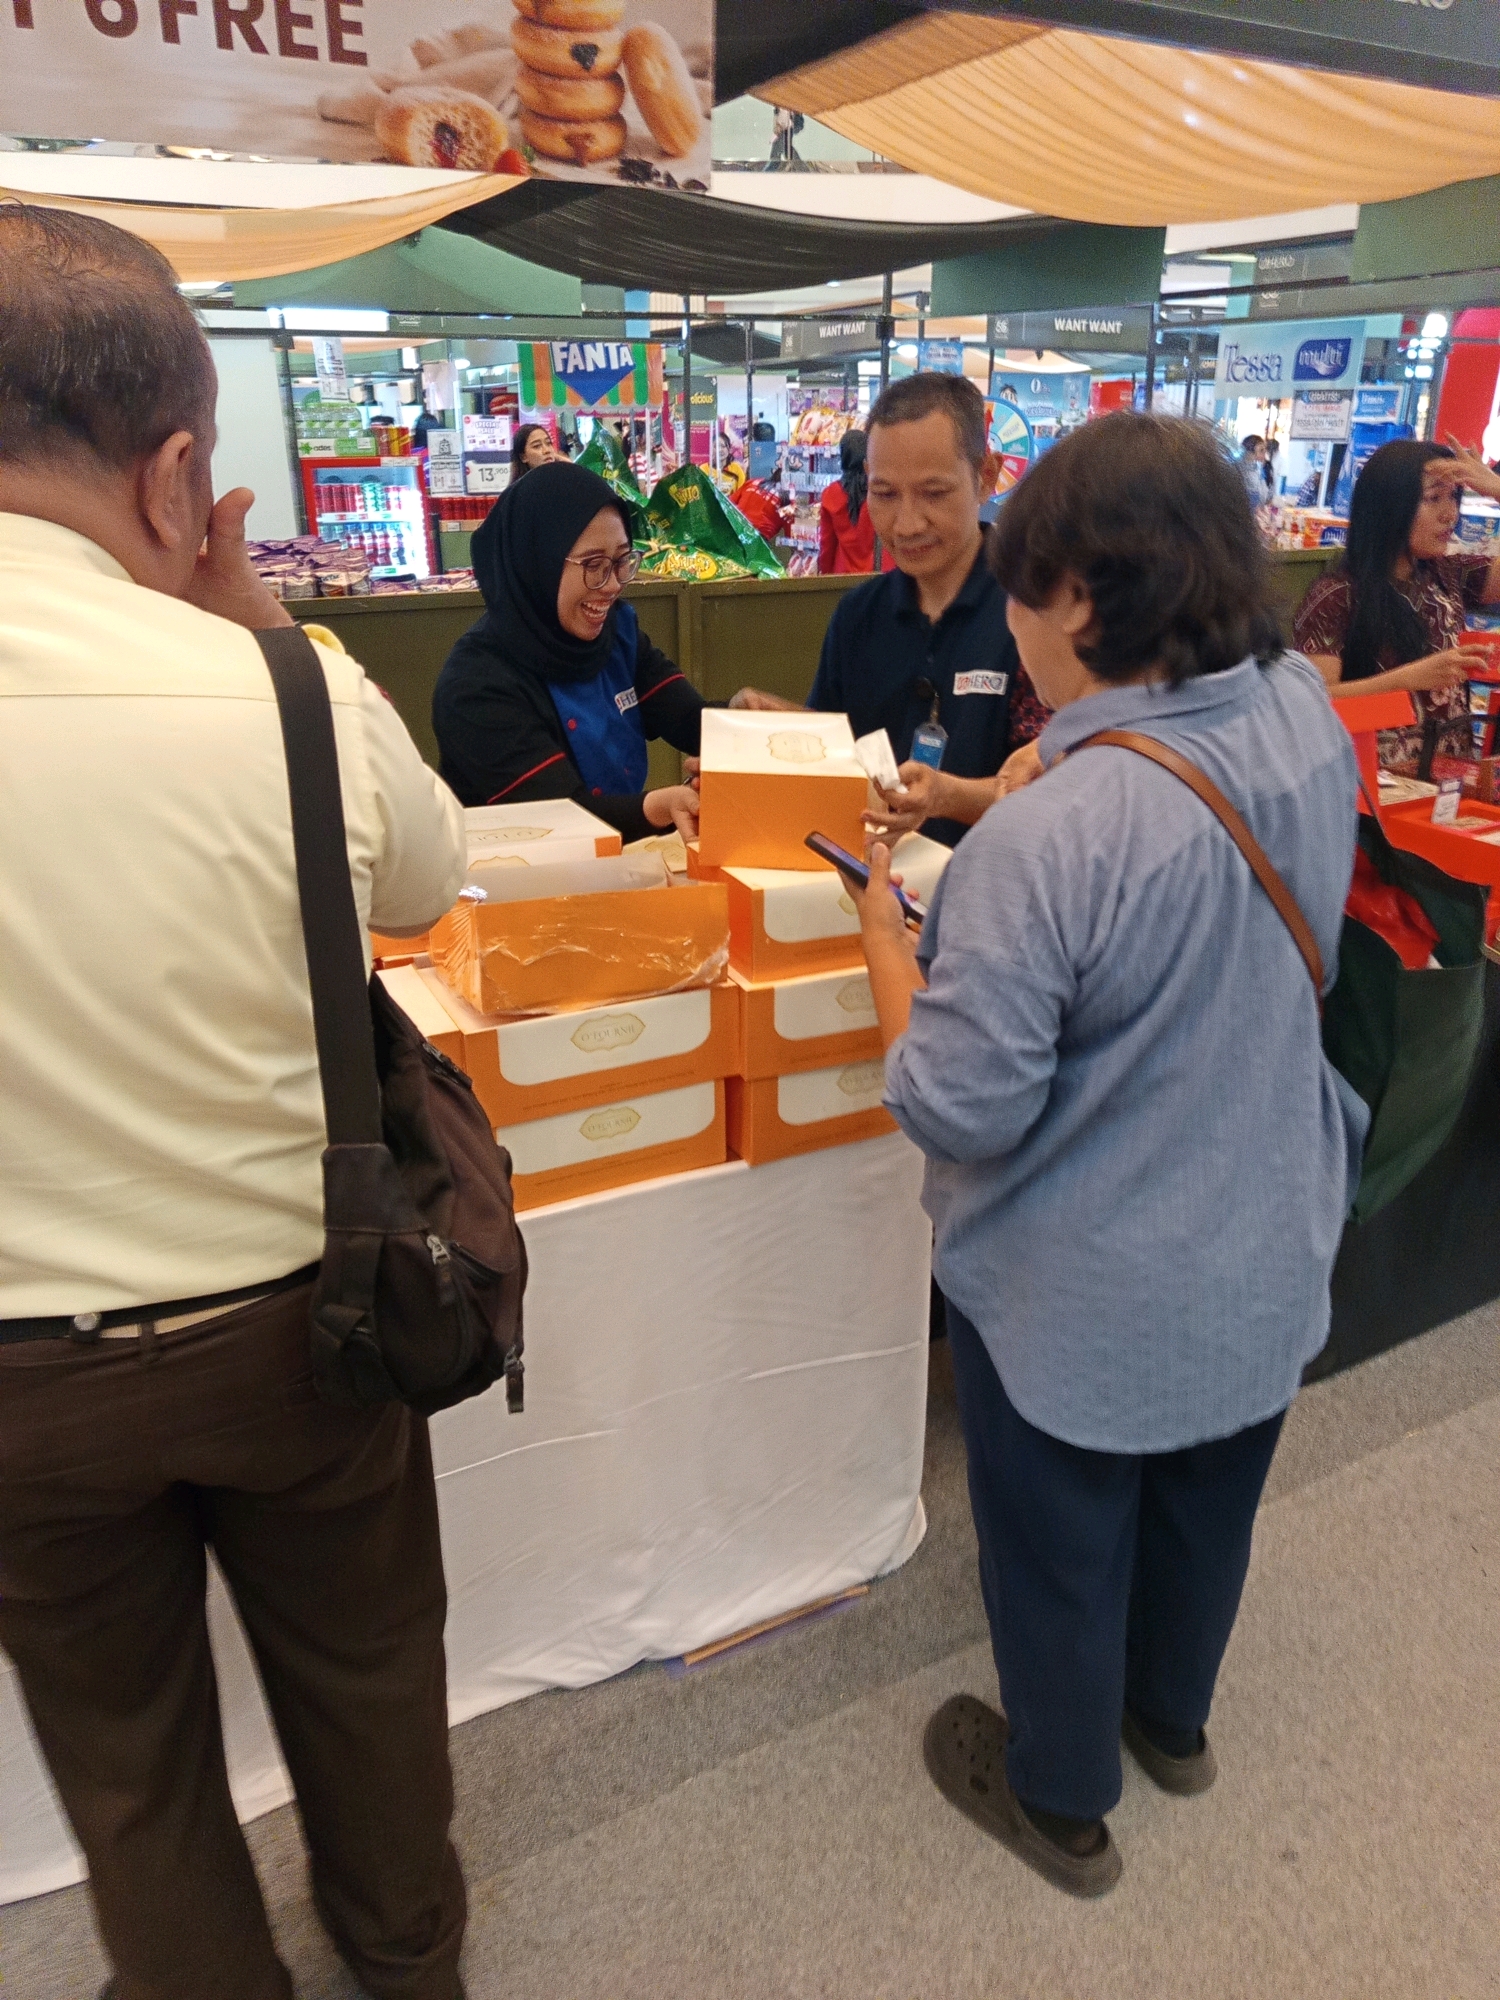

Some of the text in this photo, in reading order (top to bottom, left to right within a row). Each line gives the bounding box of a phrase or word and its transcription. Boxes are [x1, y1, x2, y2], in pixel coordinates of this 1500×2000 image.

[819, 321, 866, 338] WANT WANT
[1054, 317, 1088, 333] WANT
[1089, 319, 1123, 334] WANT
[552, 341, 634, 374] FANTA
[1225, 342, 1342, 382] Tessa multi
